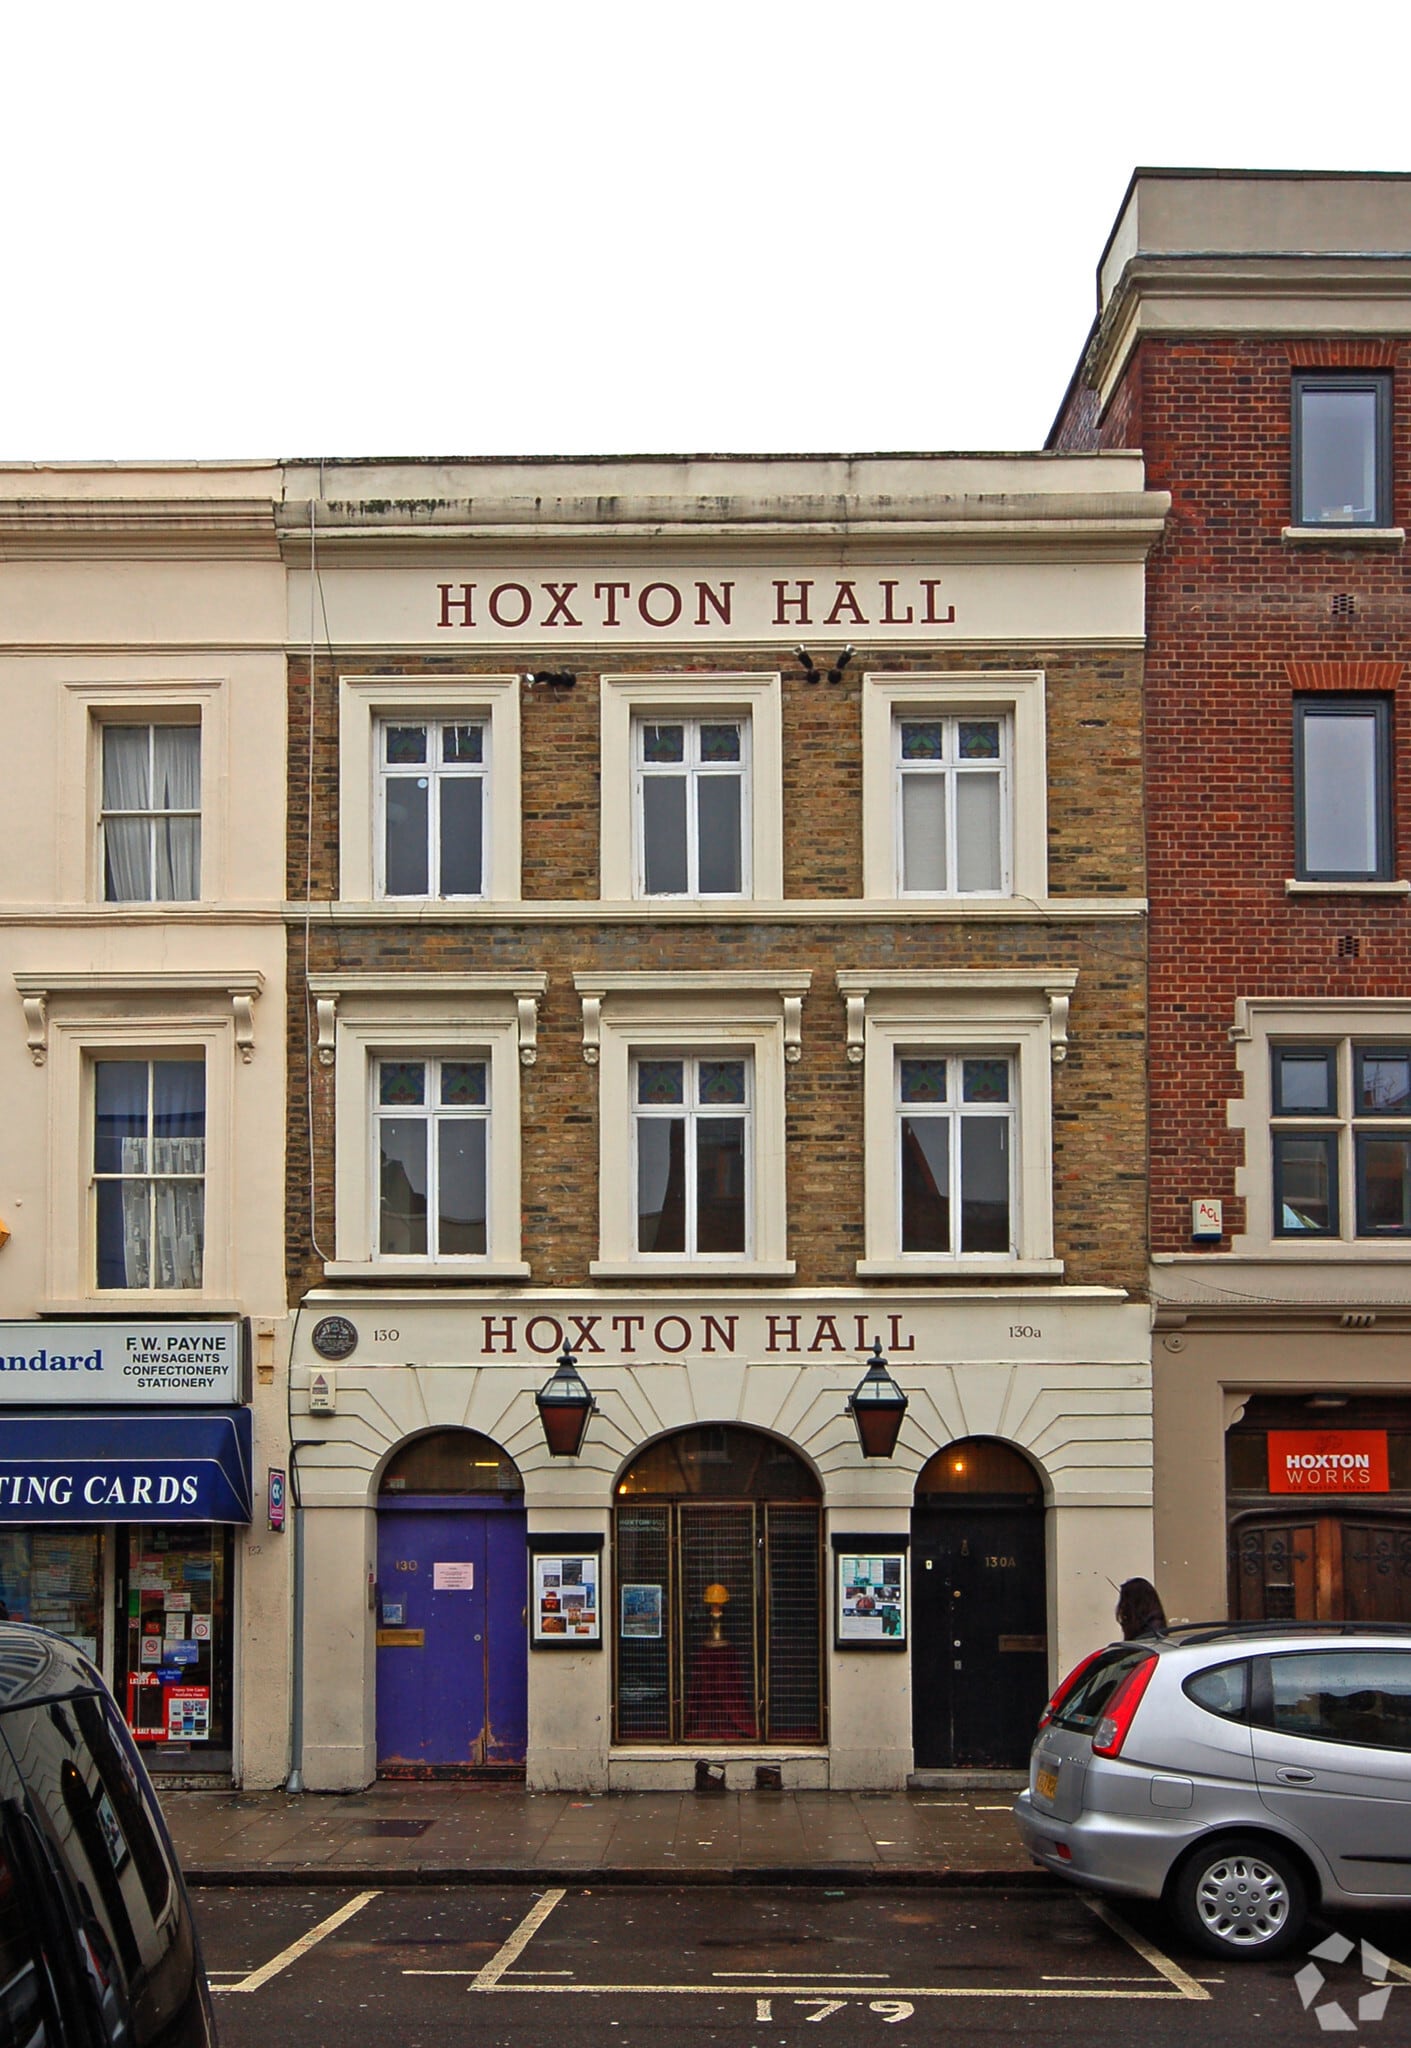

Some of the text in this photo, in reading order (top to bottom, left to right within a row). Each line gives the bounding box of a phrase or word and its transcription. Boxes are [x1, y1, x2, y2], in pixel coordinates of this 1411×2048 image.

[437, 579, 956, 628] HOXTON HALL
[1200, 1203, 1220, 1223] ACL
[373, 1328, 400, 1342] 130
[480, 1314, 915, 1354] HOXTON HALL
[1008, 1325, 1042, 1339] 130a
[167, 1337, 226, 1351] PAYNE
[132, 1353, 220, 1363] NEWSAGENTS
[123, 1365, 229, 1375] CONFECTIONERY
[137, 1378, 214, 1388] STATIONERY
[1286, 1454, 1370, 1469] HOXTON
[1286, 1469, 1371, 1484] WORKS
[83, 1475, 199, 1505] CARDS
[395, 1560, 418, 1571] 130
[756, 1999, 915, 2023] 179
